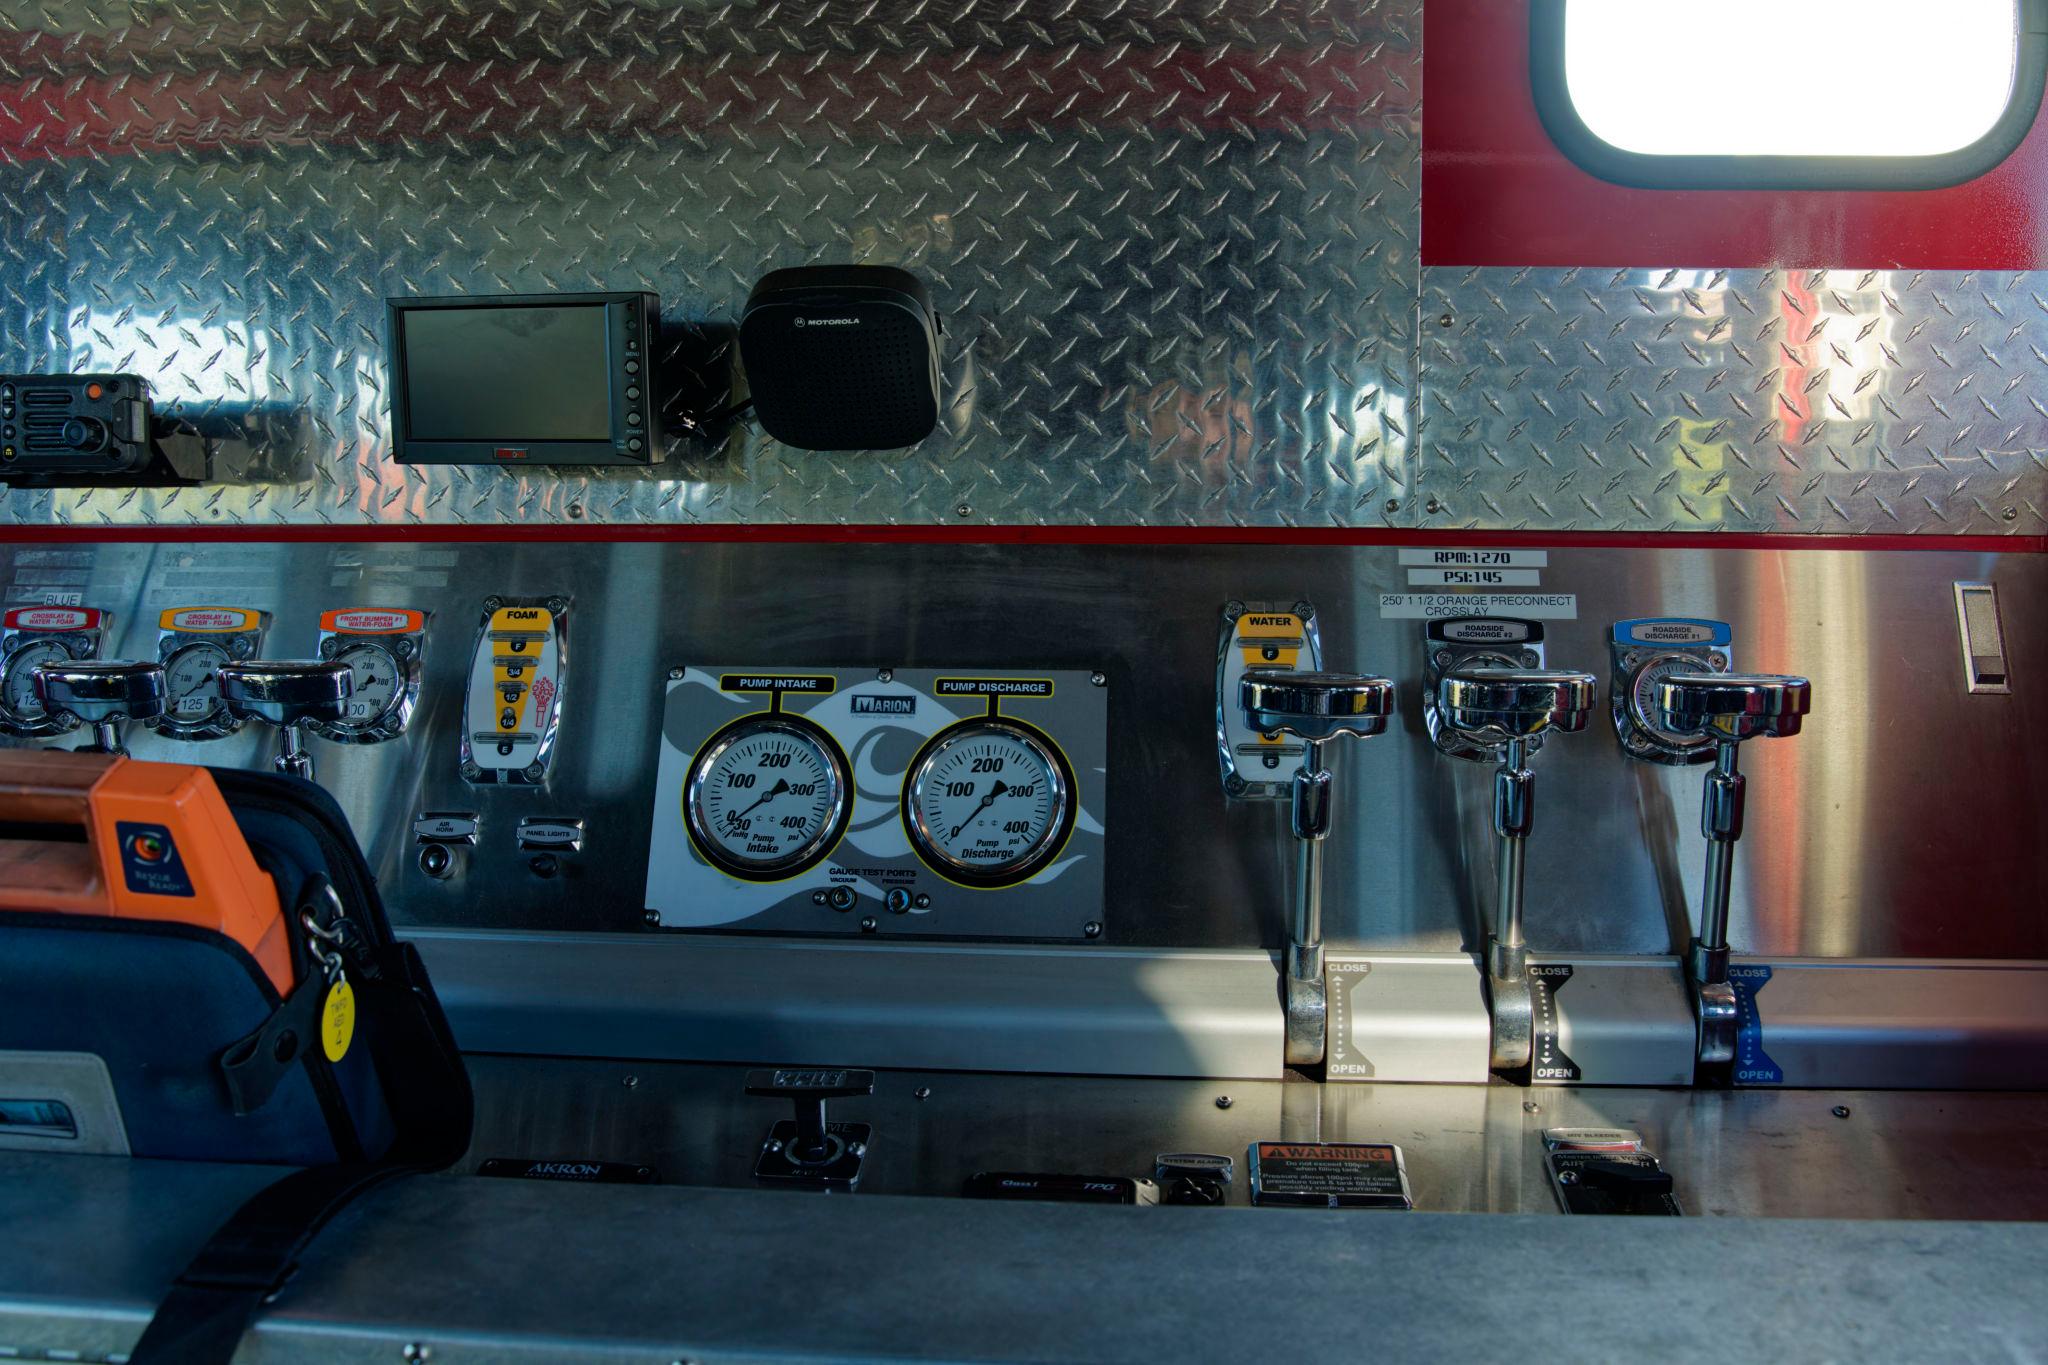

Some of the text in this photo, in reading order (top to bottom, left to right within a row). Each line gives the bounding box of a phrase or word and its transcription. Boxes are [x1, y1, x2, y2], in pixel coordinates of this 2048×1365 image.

[808, 318, 860, 326] MOTOROLA
[1434, 552, 1511, 564] RPM:1270
[1444, 571, 1503, 583] PSI:145
[46, 594, 79, 606] BLUE
[1418, 596, 1434, 605] 1/2
[1437, 596, 1487, 606] ORANGE
[1491, 597, 1572, 606] PRECONNECT
[507, 610, 538, 620] FOAM
[1425, 606, 1489, 616] CROSSLAY
[1249, 617, 1292, 626] WATER
[1645, 632, 1689, 640] DISCHARGE
[515, 642, 521, 650] F
[1267, 650, 1274, 659] F
[199, 661, 212, 669] 200
[362, 662, 375, 670] 200
[180, 674, 193, 682] 100
[376, 678, 389, 686] 300
[740, 679, 817, 688] PUMP INTAKE
[943, 682, 1046, 692] PUMP DISCHARGE
[182, 701, 203, 710] 125
[856, 697, 911, 712] MARION
[502, 719, 514, 727] 1/4
[758, 753, 791, 768] 200
[971, 758, 1004, 773] 200
[1267, 758, 1275, 766] E
[727, 773, 756, 788] 100
[789, 783, 815, 796] 300
[945, 782, 975, 797] 100
[1007, 785, 1034, 798] 300
[727, 810, 736, 823] 0
[780, 816, 806, 829] 400
[1003, 821, 1030, 833] 400
[951, 826, 960, 838] 0
[752, 833, 775, 844] Pump
[787, 834, 799, 842] psi
[1008, 838, 1020, 846] psi
[747, 843, 779, 854] Intake
[976, 839, 999, 849] Pump
[962, 849, 1014, 861] Discharge
[829, 868, 860, 876] GAUGE
[886, 869, 917, 877] PORTS
[1328, 963, 1368, 972] CLOSE
[1530, 967, 1570, 976] CLOSE
[1729, 968, 1768, 978] CLOSE
[1330, 1064, 1366, 1074] OPEN
[1536, 1068, 1573, 1078] OPEN
[1738, 1070, 1774, 1080] OPEN
[1287, 1147, 1384, 1160] WARNING
[528, 1163, 601, 1175] AKRON
[1083, 1182, 1117, 1191] TPG
[1315, 1185, 1345, 1193] voiding
